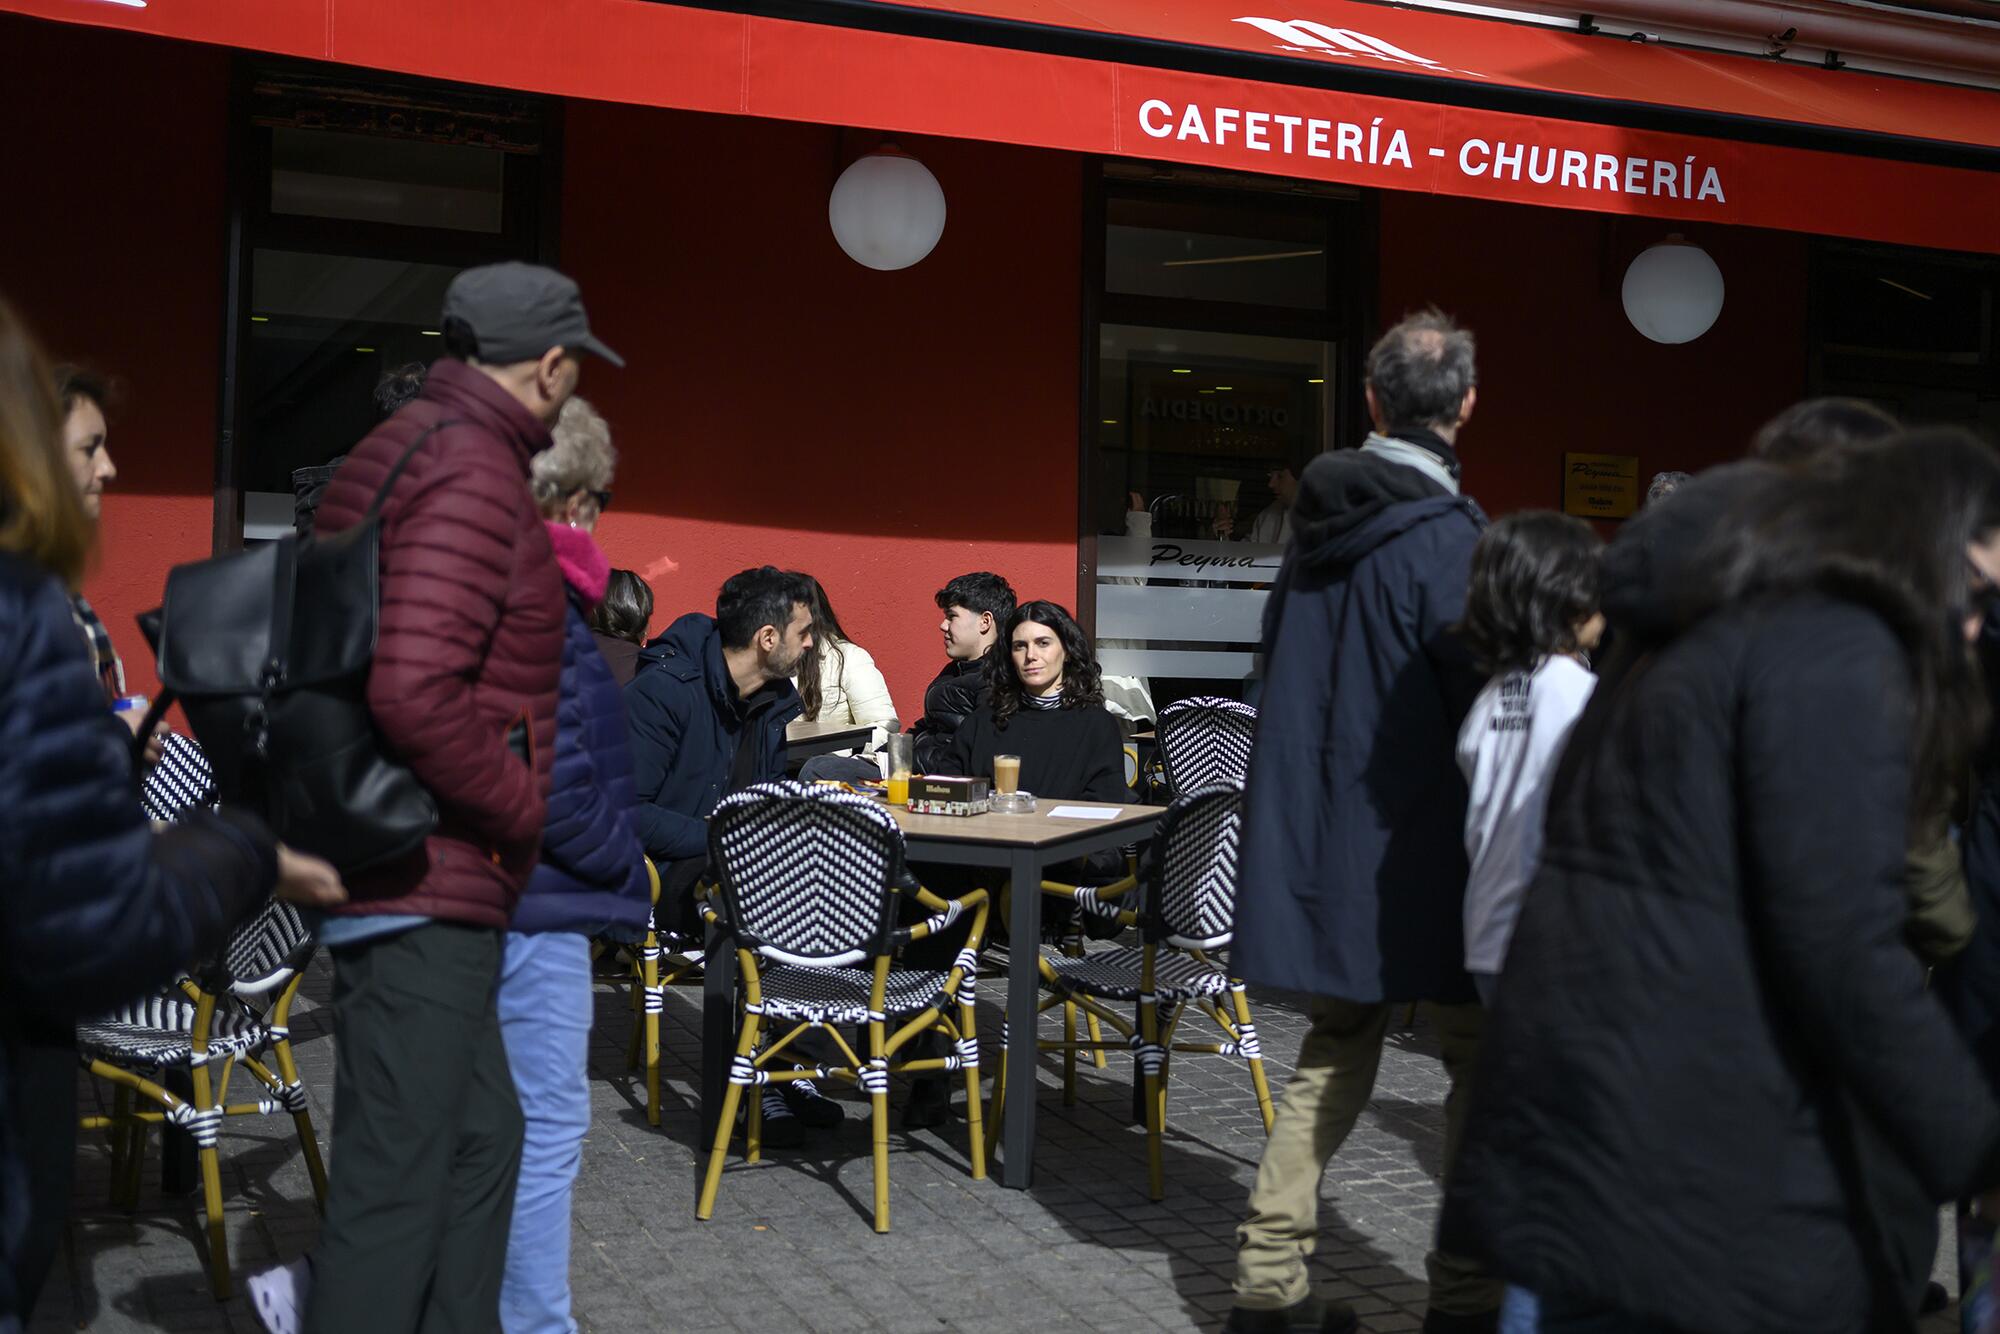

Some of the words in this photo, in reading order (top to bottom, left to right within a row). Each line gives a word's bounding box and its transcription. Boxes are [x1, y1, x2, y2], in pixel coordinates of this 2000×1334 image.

[1138, 98, 1414, 169] CAFETERÍA
[1458, 138, 1727, 204] CHURRERÍA
[1150, 544, 1281, 573] Peyma
